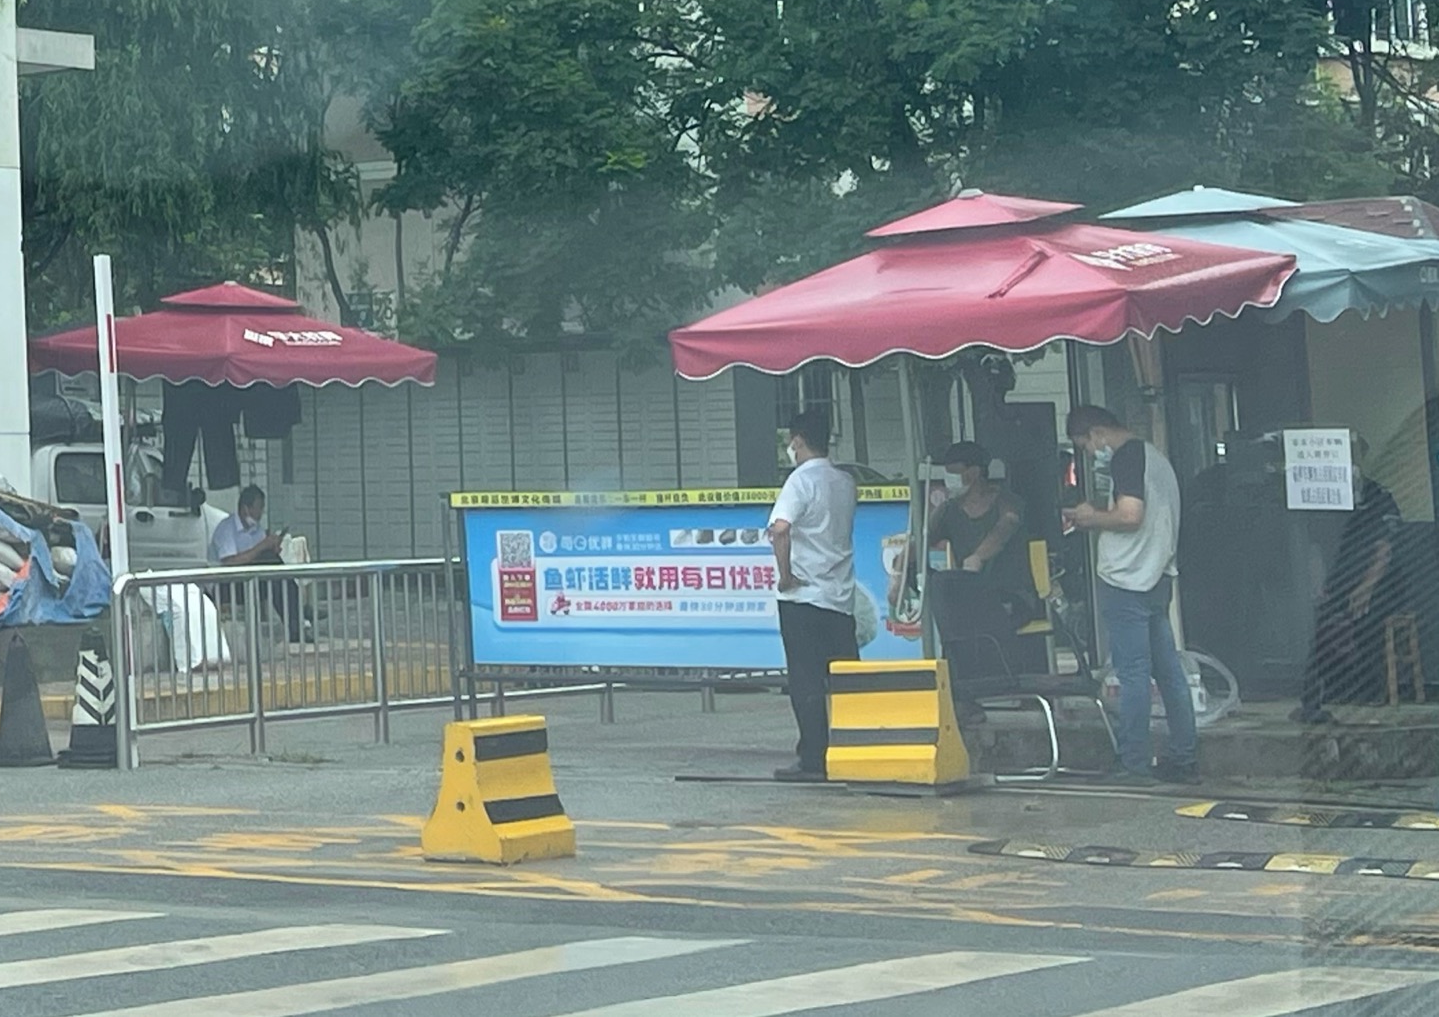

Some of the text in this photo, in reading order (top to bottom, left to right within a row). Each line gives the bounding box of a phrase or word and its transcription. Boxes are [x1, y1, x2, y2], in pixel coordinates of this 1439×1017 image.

[560, 535, 613, 552] 每日优鲜
[544, 565, 776, 591] 鱼虾活鲜就用每日优鲜
